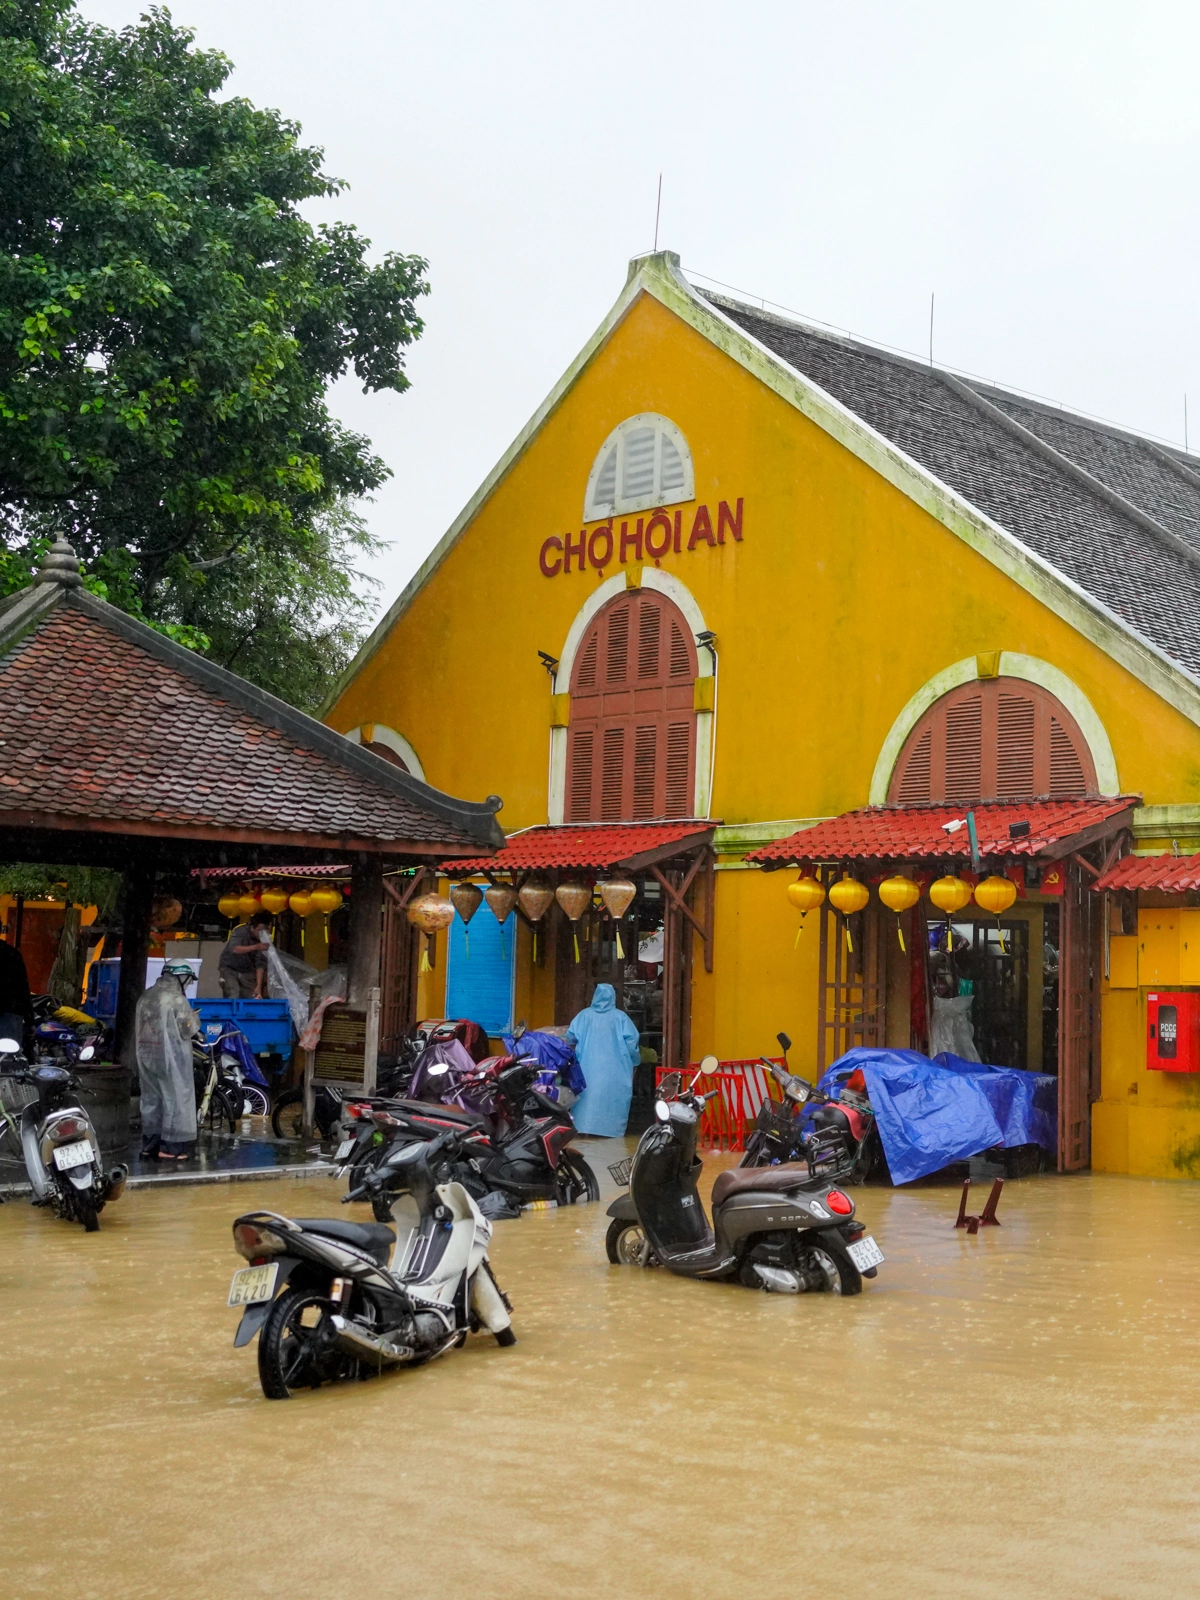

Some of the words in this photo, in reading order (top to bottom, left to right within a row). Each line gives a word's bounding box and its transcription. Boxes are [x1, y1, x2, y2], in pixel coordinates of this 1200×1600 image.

[539, 518, 615, 578] CHỢ
[619, 507, 682, 568] HỘI
[687, 497, 744, 550] AN
[1160, 1024, 1176, 1032] PCCC
